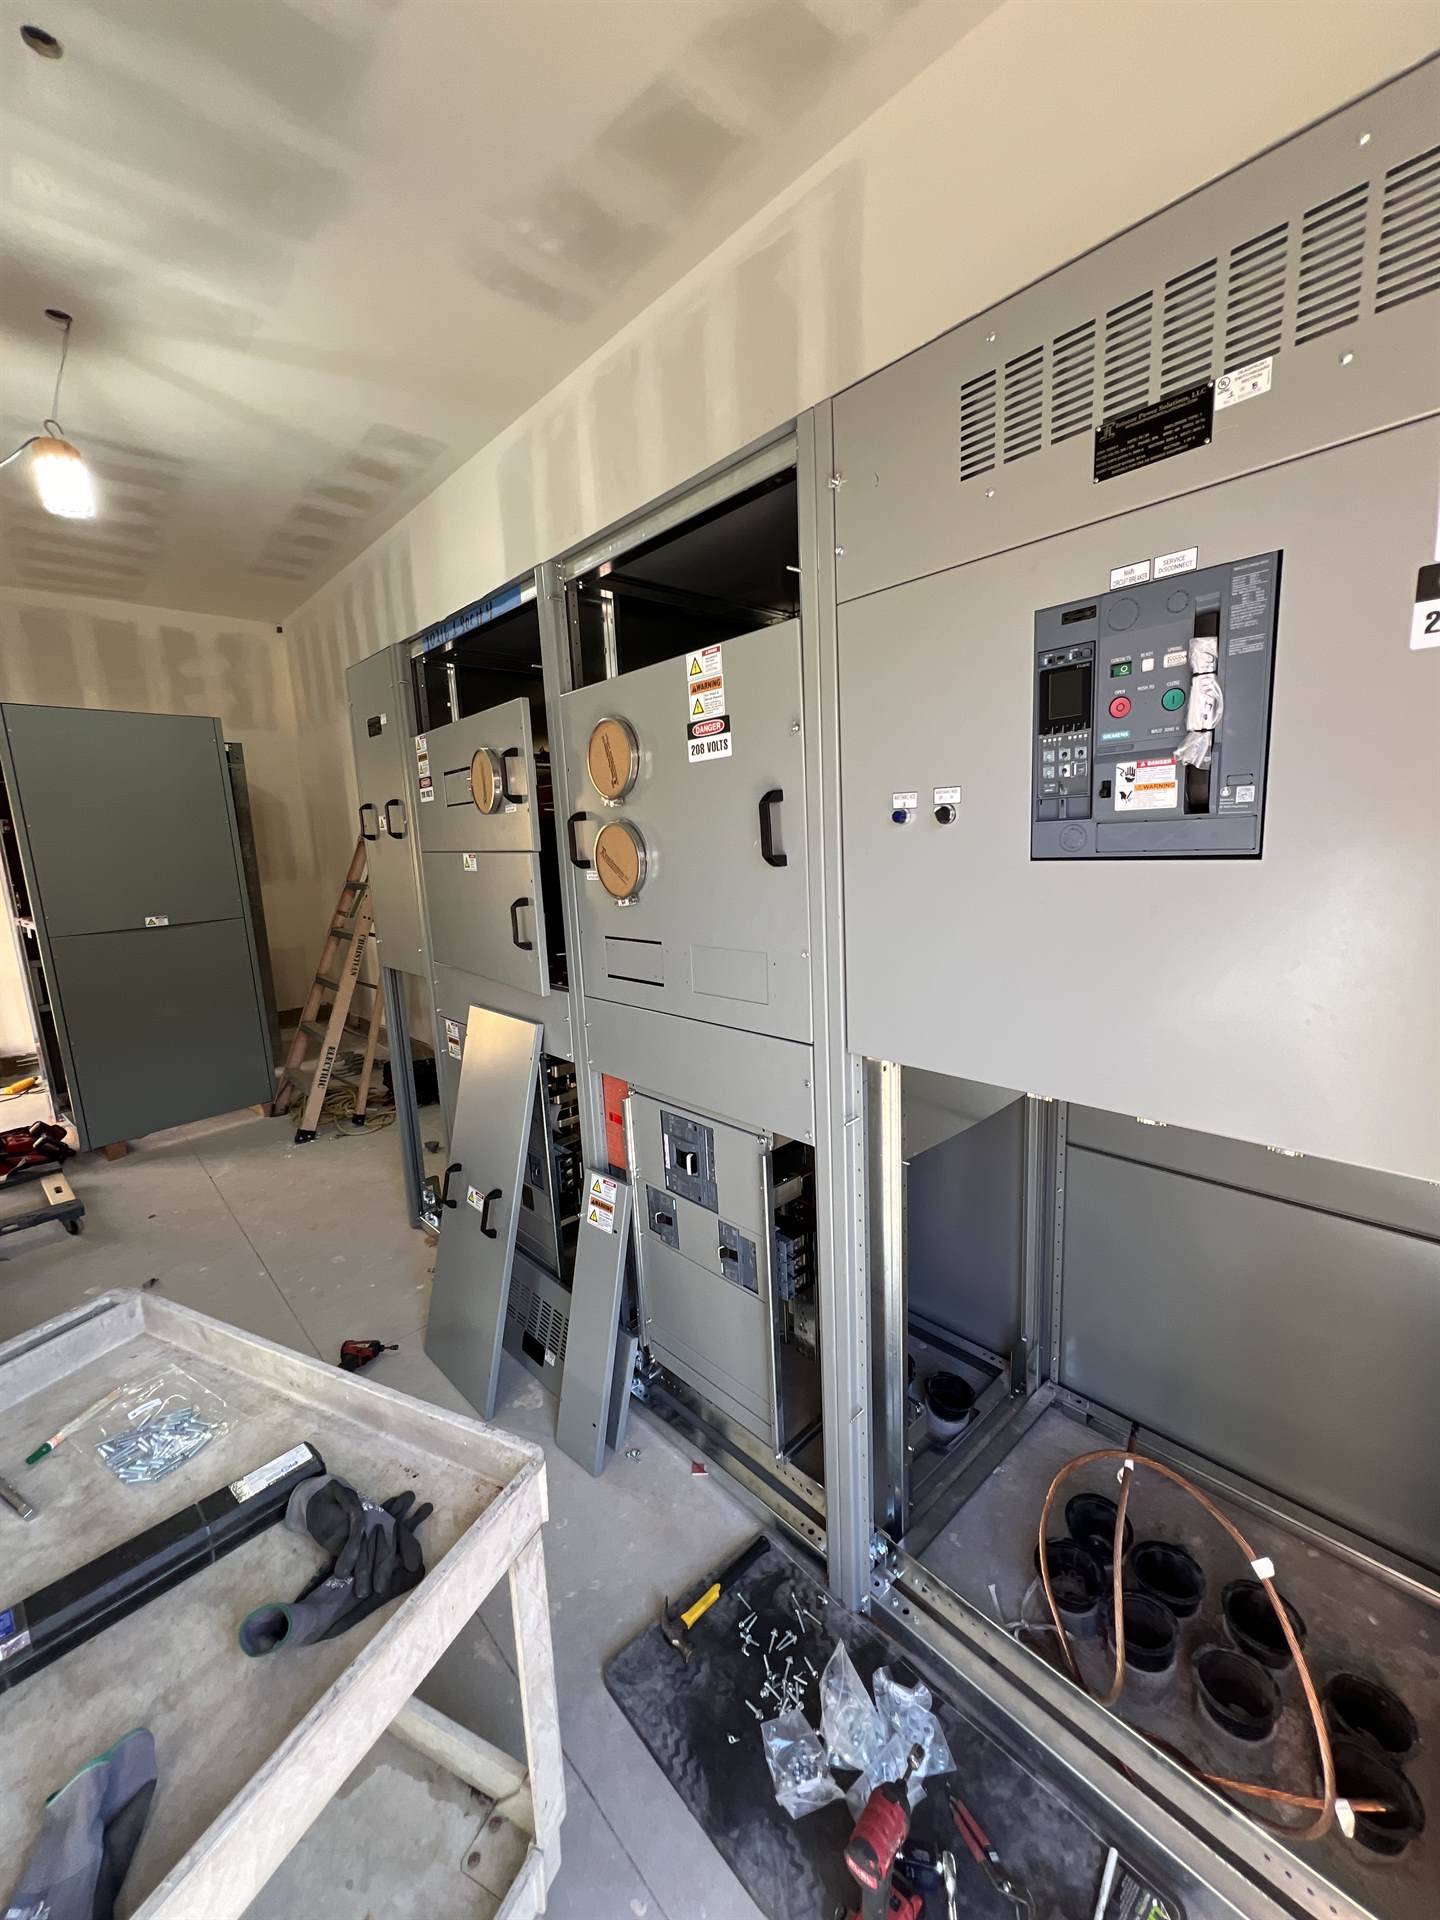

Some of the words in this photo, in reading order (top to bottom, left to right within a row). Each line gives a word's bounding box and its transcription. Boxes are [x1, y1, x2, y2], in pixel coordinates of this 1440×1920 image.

[1190, 386, 1207, 398] LLC
[1158, 560, 1193, 574] DISCONNECT
[1162, 555, 1185, 567] SERVICE
[1123, 568, 1135, 576] MAIN
[1112, 577, 1128, 588] CIRCUIT
[1128, 573, 1148, 584] BREAKER
[696, 678, 721, 692] WARNING
[695, 721, 721, 735] DANGER
[1102, 731, 1129, 740] SIEMENS
[691, 743, 705, 756] 208
[706, 739, 729, 753] VOLTS
[1143, 782, 1176, 790] WARNING
[350, 934, 366, 976] CHRISTIAN
[317, 1046, 336, 1089] ELECTRIC
